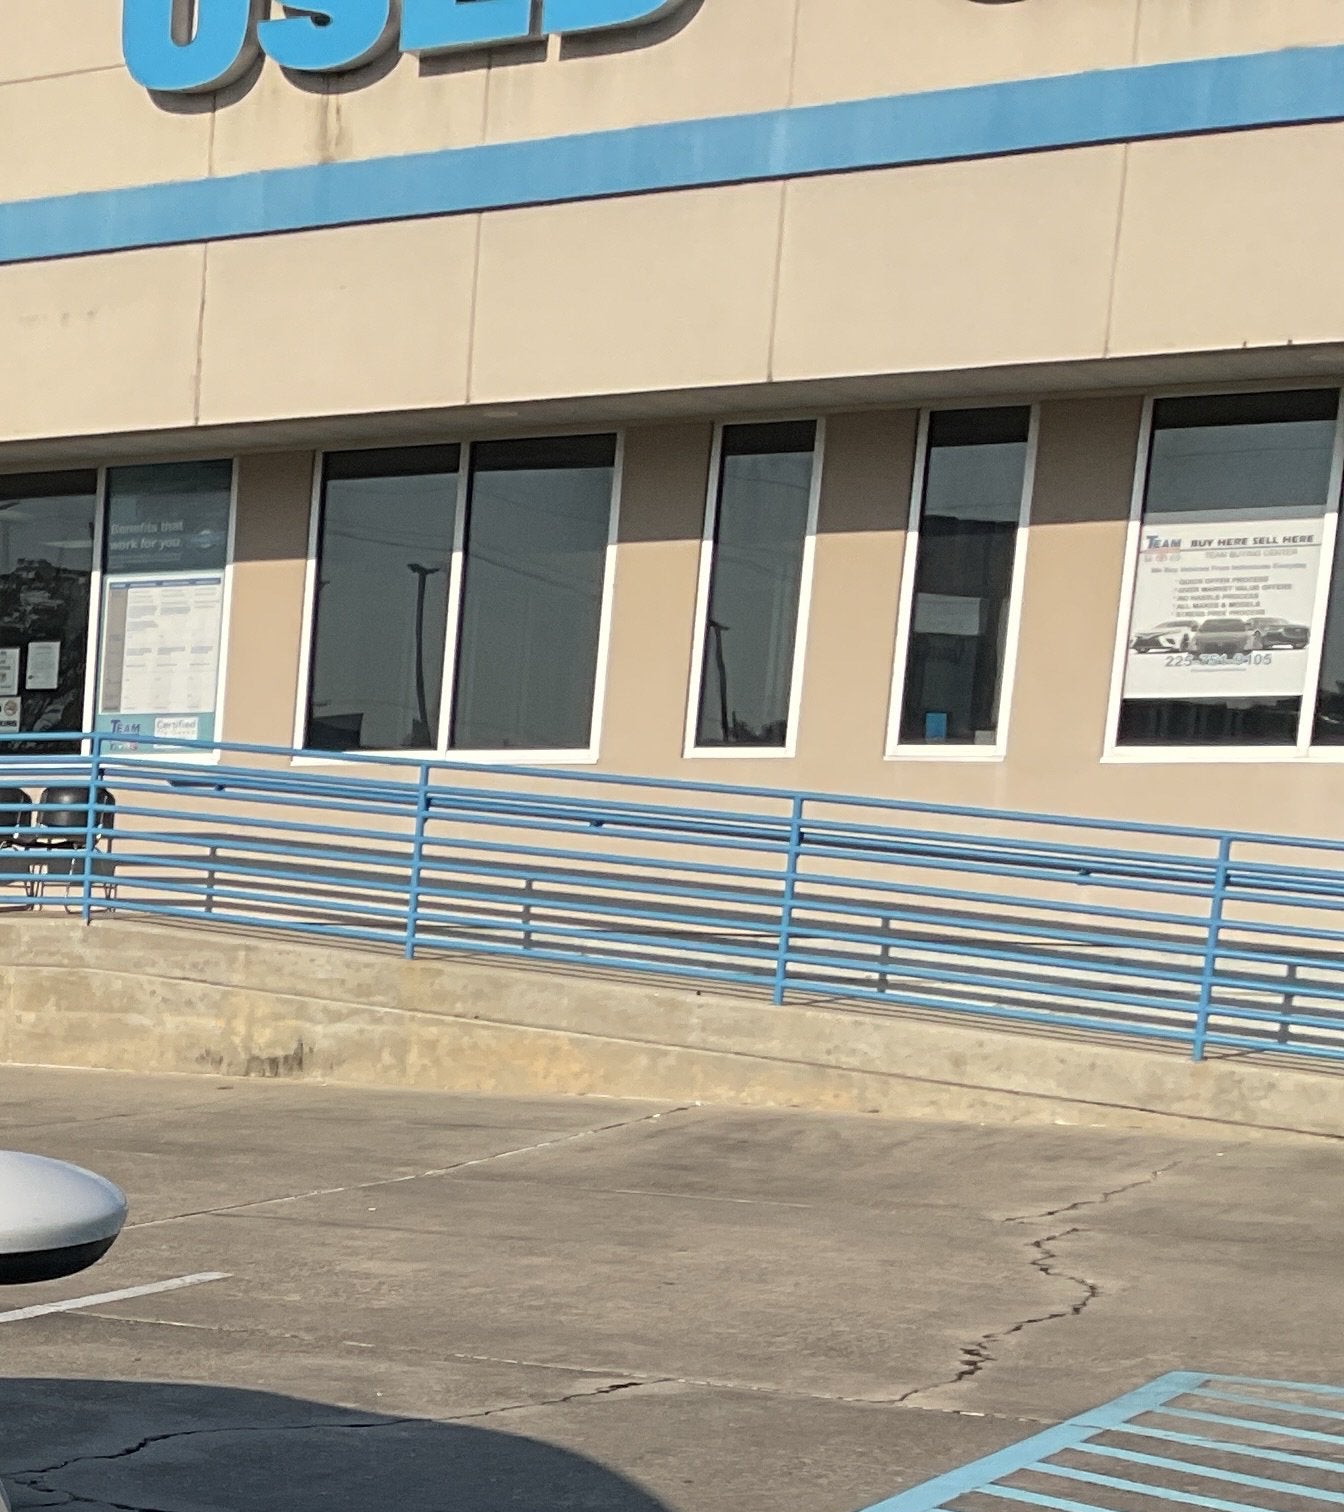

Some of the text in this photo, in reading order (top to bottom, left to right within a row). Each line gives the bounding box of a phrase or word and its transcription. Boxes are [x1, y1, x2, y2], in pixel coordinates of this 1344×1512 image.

[120, 0, 704, 95] US
[160, 521, 184, 532] that
[110, 538, 182, 551] work for you
[1146, 534, 1315, 549] TEAM BUY HERE SELL HERE
[111, 719, 141, 734] TEAM
